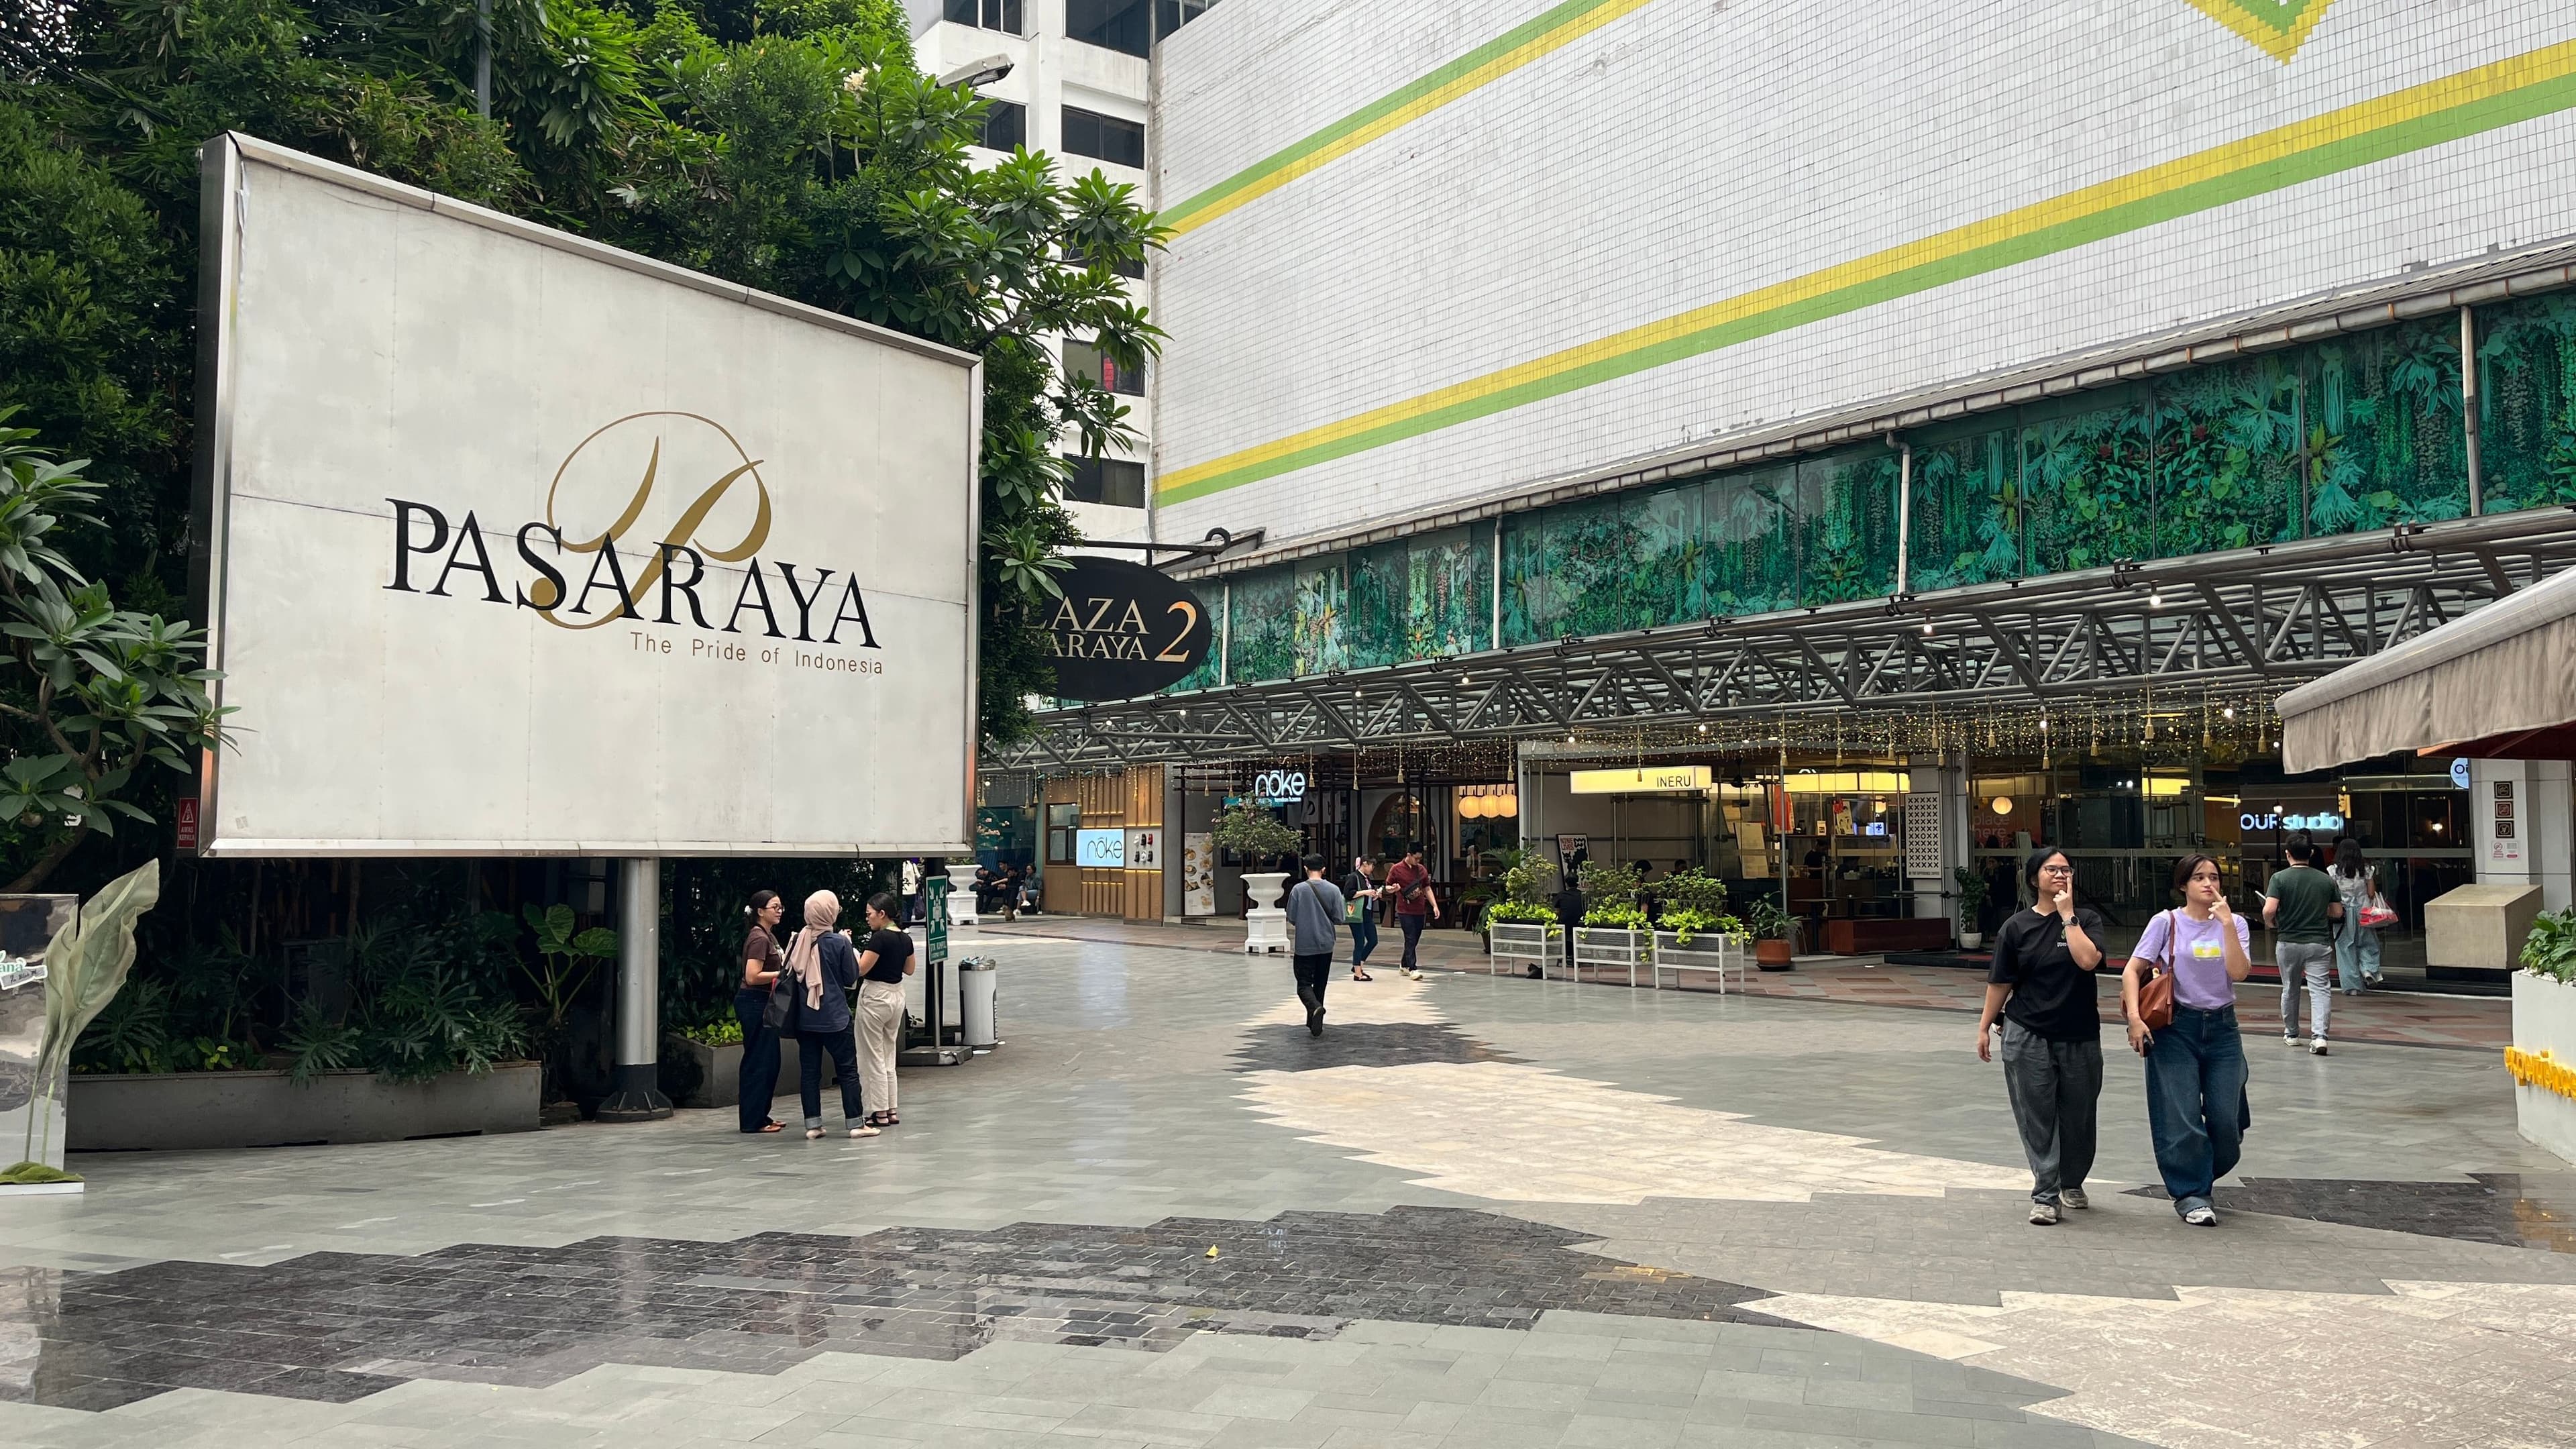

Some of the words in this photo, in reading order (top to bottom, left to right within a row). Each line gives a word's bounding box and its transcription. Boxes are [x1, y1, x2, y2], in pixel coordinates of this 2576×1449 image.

[382, 498, 882, 649] PASARAYA
[1154, 600, 1197, 663] 2
[630, 632, 672, 655] The
[692, 639, 747, 663] Pride
[761, 647, 781, 665] of
[795, 649, 883, 676] Indonesia
[1656, 775, 1691, 788] INERU
[2282, 812, 2344, 830] studio
